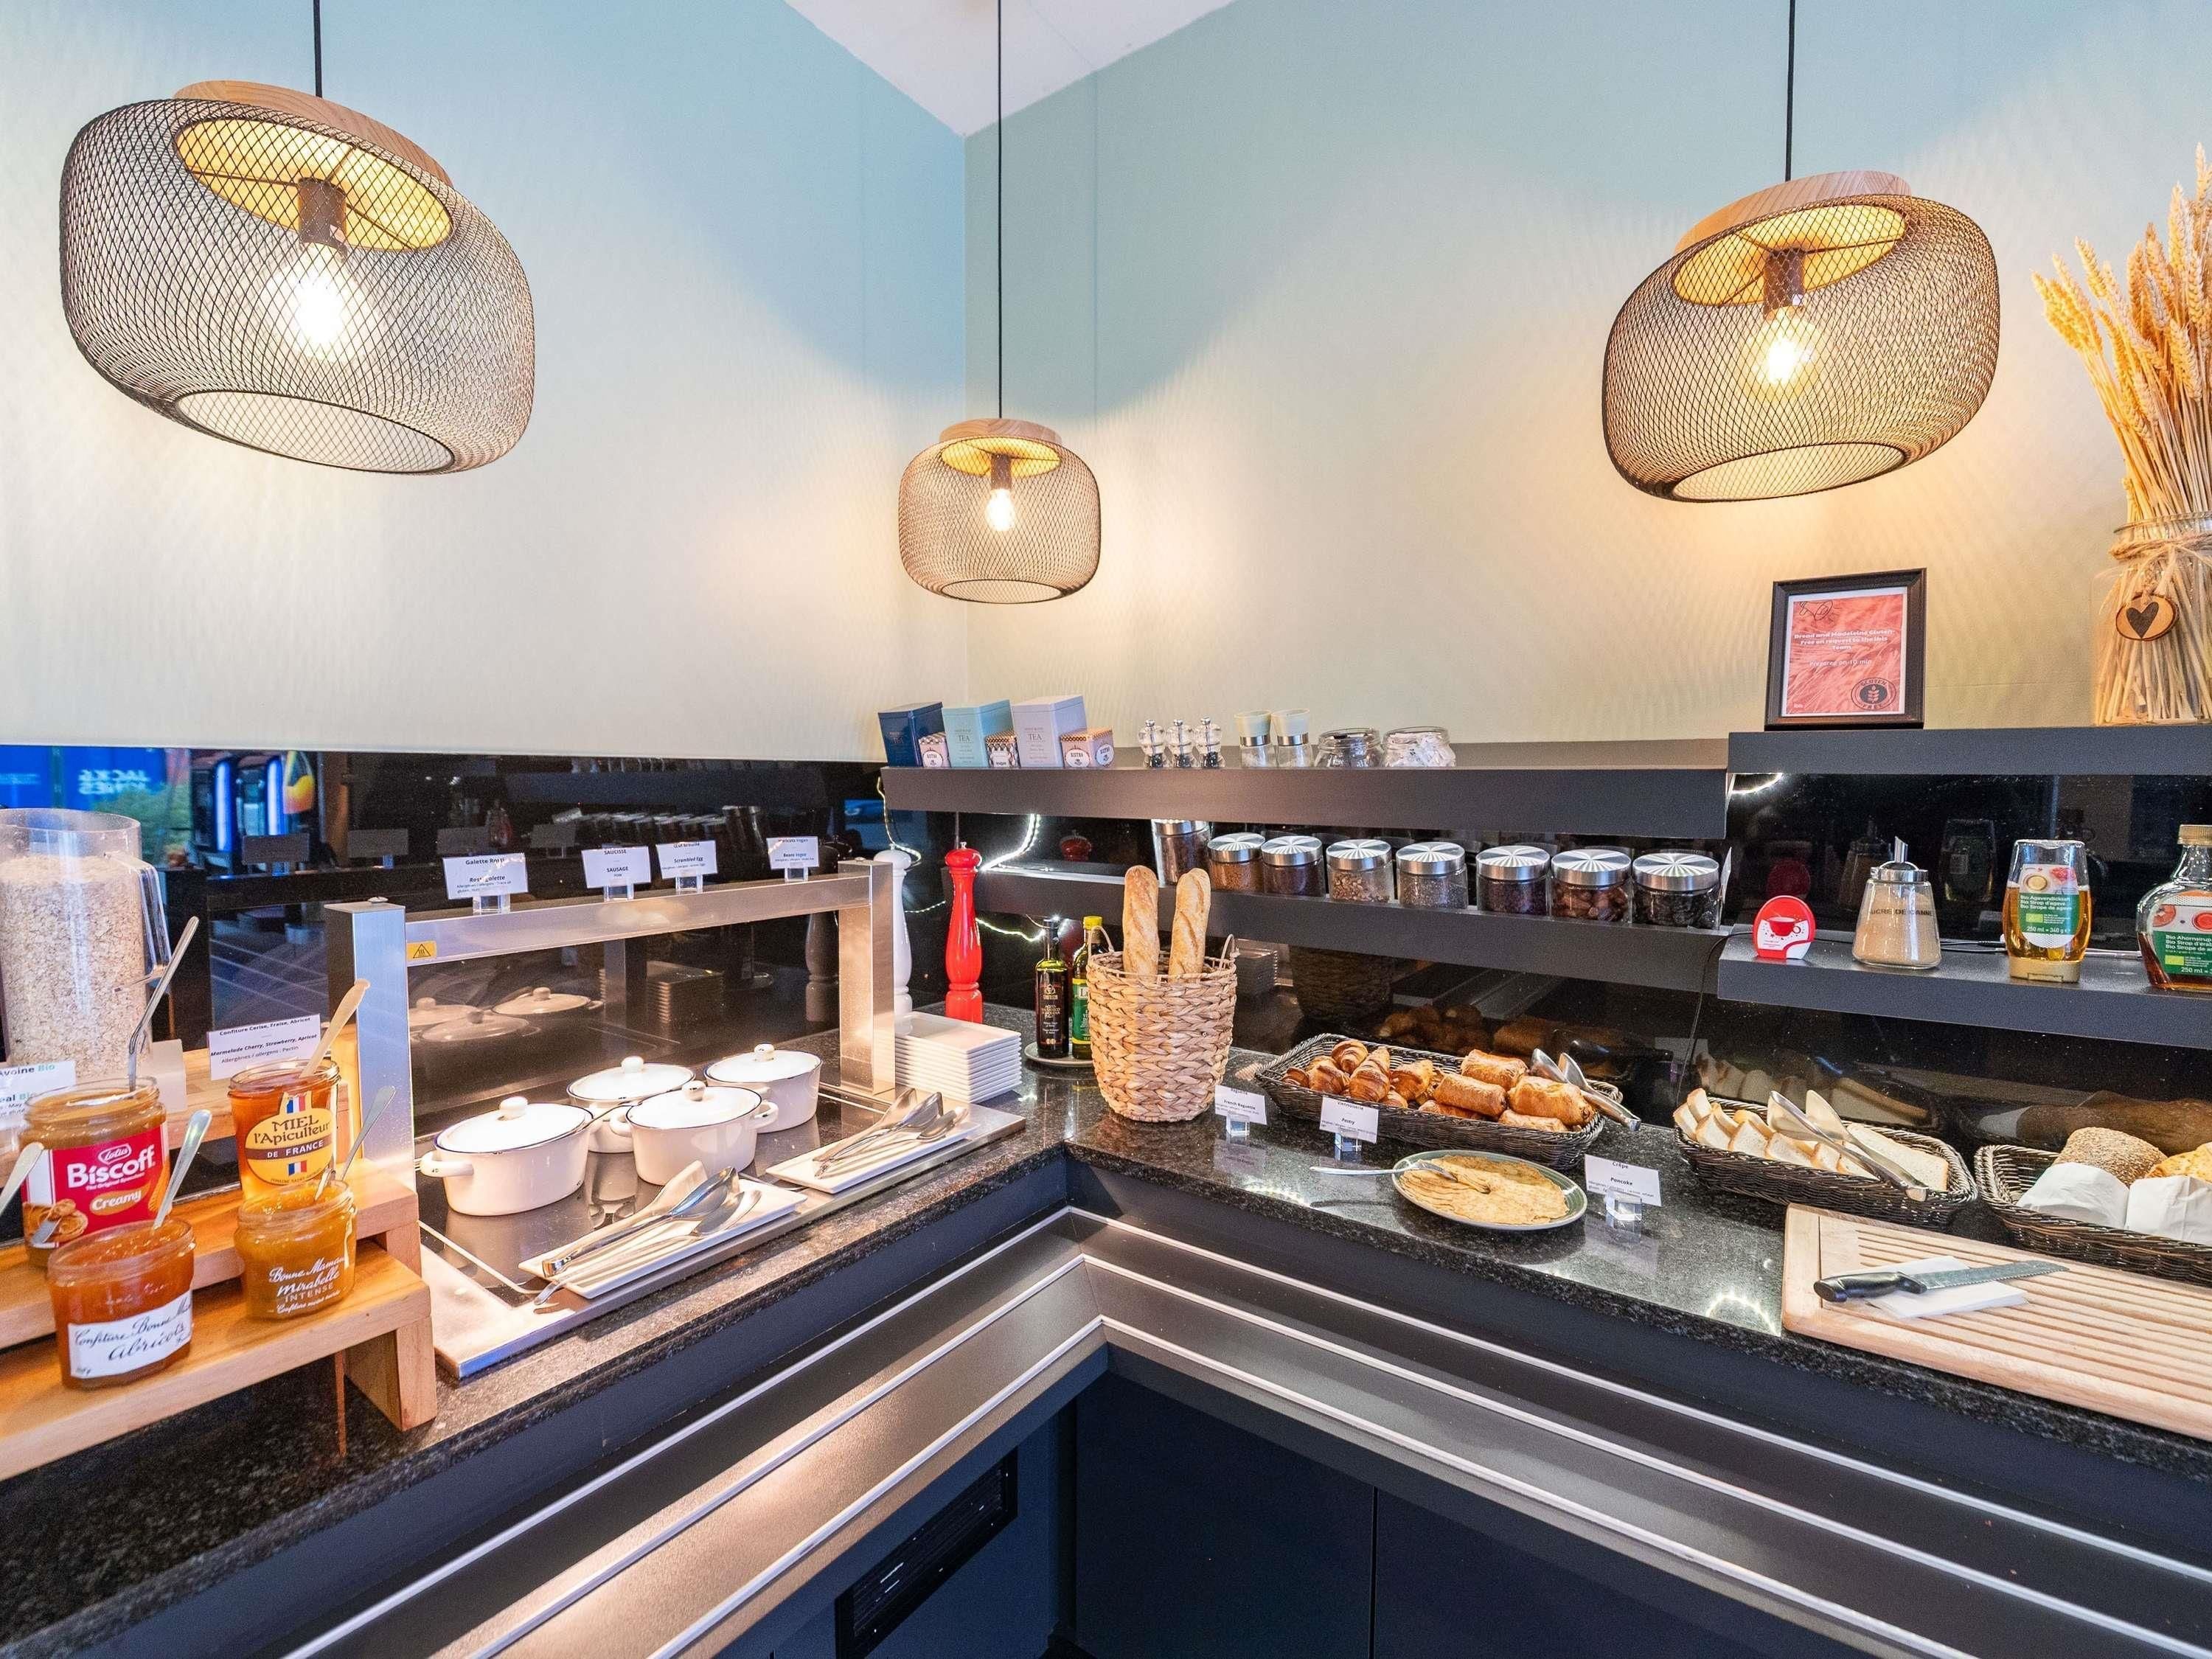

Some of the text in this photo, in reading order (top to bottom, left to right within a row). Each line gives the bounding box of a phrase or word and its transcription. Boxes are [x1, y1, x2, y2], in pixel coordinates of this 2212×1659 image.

[219, 1027, 248, 1036] Confiture
[244, 1042, 265, 1051] Cherry,
[298, 1033, 317, 1042] Apricot
[271, 1114, 319, 1132] MIEL
[253, 1121, 330, 1146] l'Apiculteur
[267, 1139, 324, 1158] DE FRANCE
[67, 1144, 156, 1189] Biscoff
[91, 1190, 142, 1211] Creamy
[268, 1266, 305, 1283] Bonne
[285, 1282, 335, 1303] INTENSE
[74, 1315, 171, 1349] Confiture Bonne
